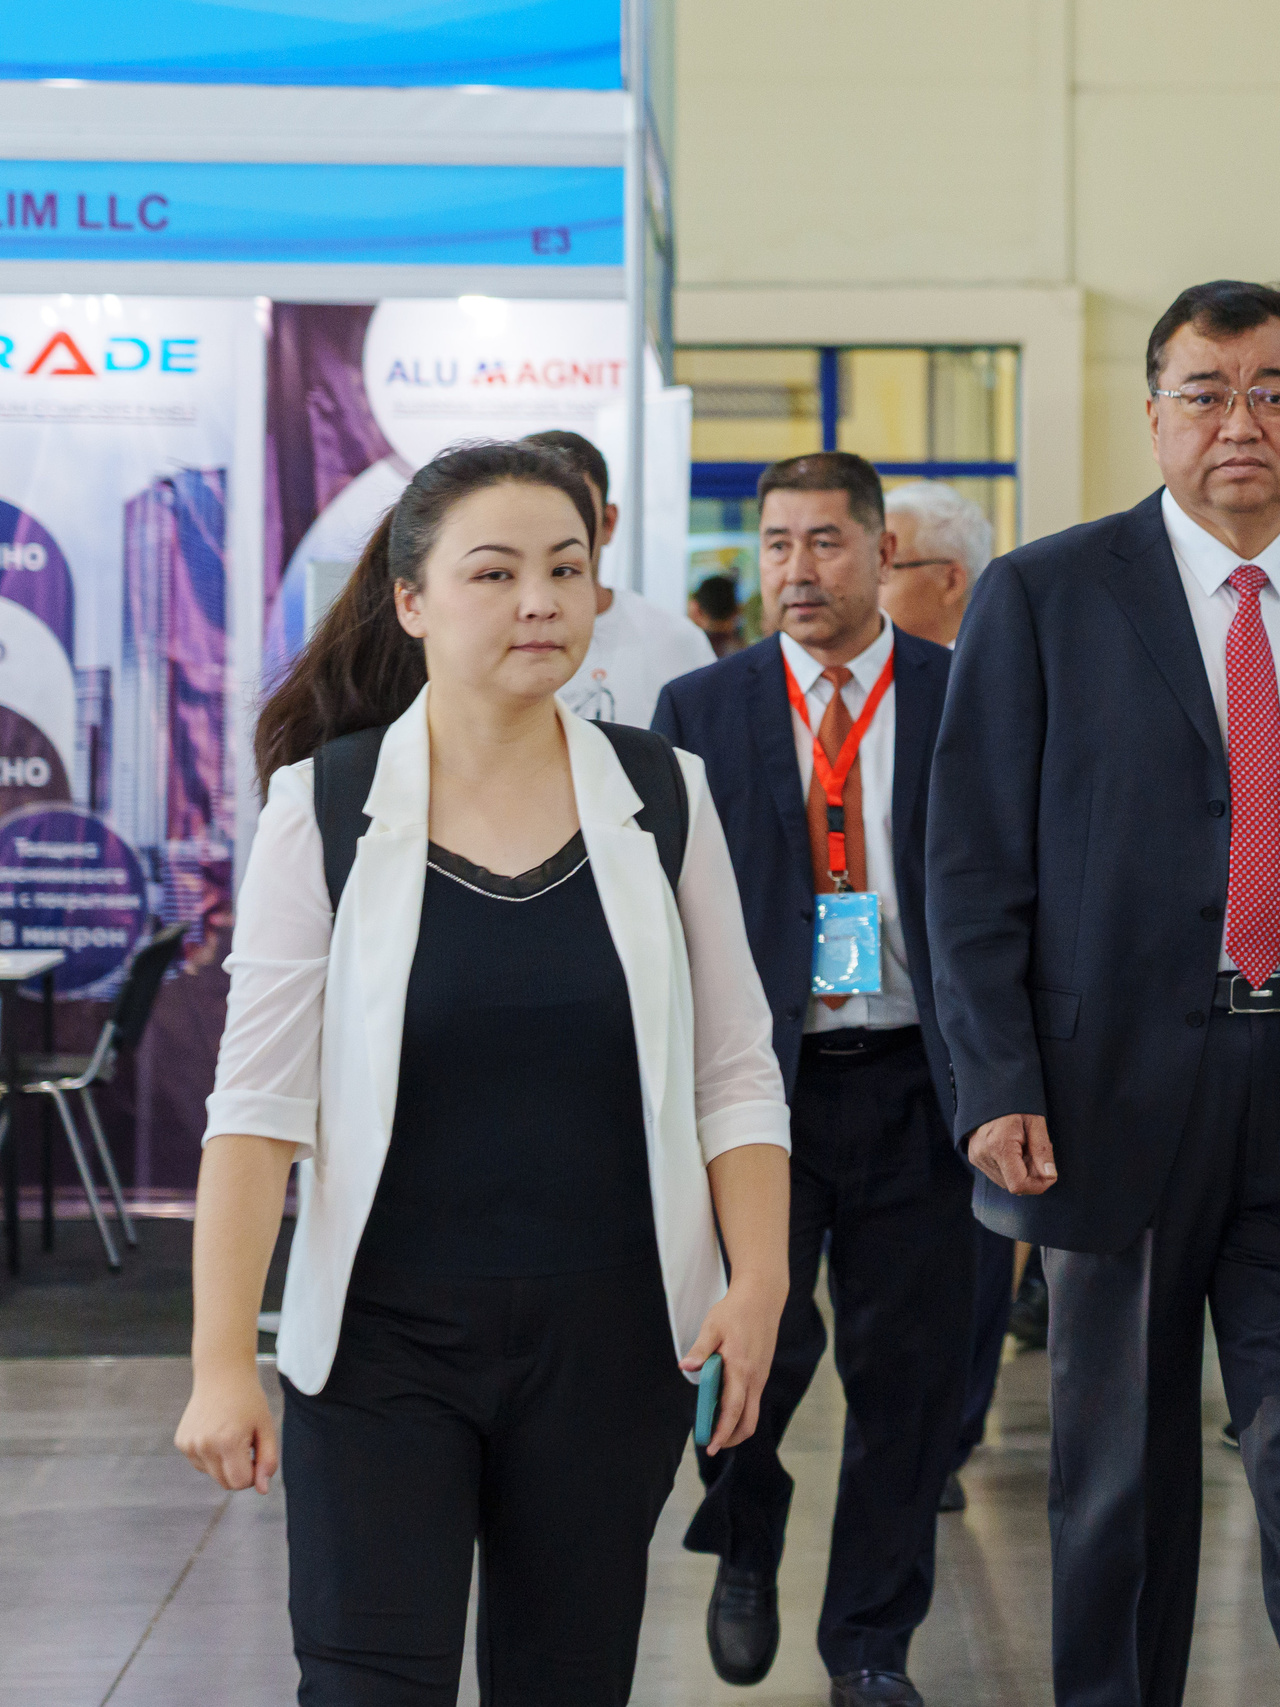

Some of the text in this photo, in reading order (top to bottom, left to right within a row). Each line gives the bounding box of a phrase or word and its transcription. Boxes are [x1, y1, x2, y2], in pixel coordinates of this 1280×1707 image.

[0, 190, 168, 232] IM LLC
[532, 226, 571, 255] E3
[386, 359, 458, 386] ALU
[0, 542, 46, 572] НО
[0, 756, 50, 788] НО
